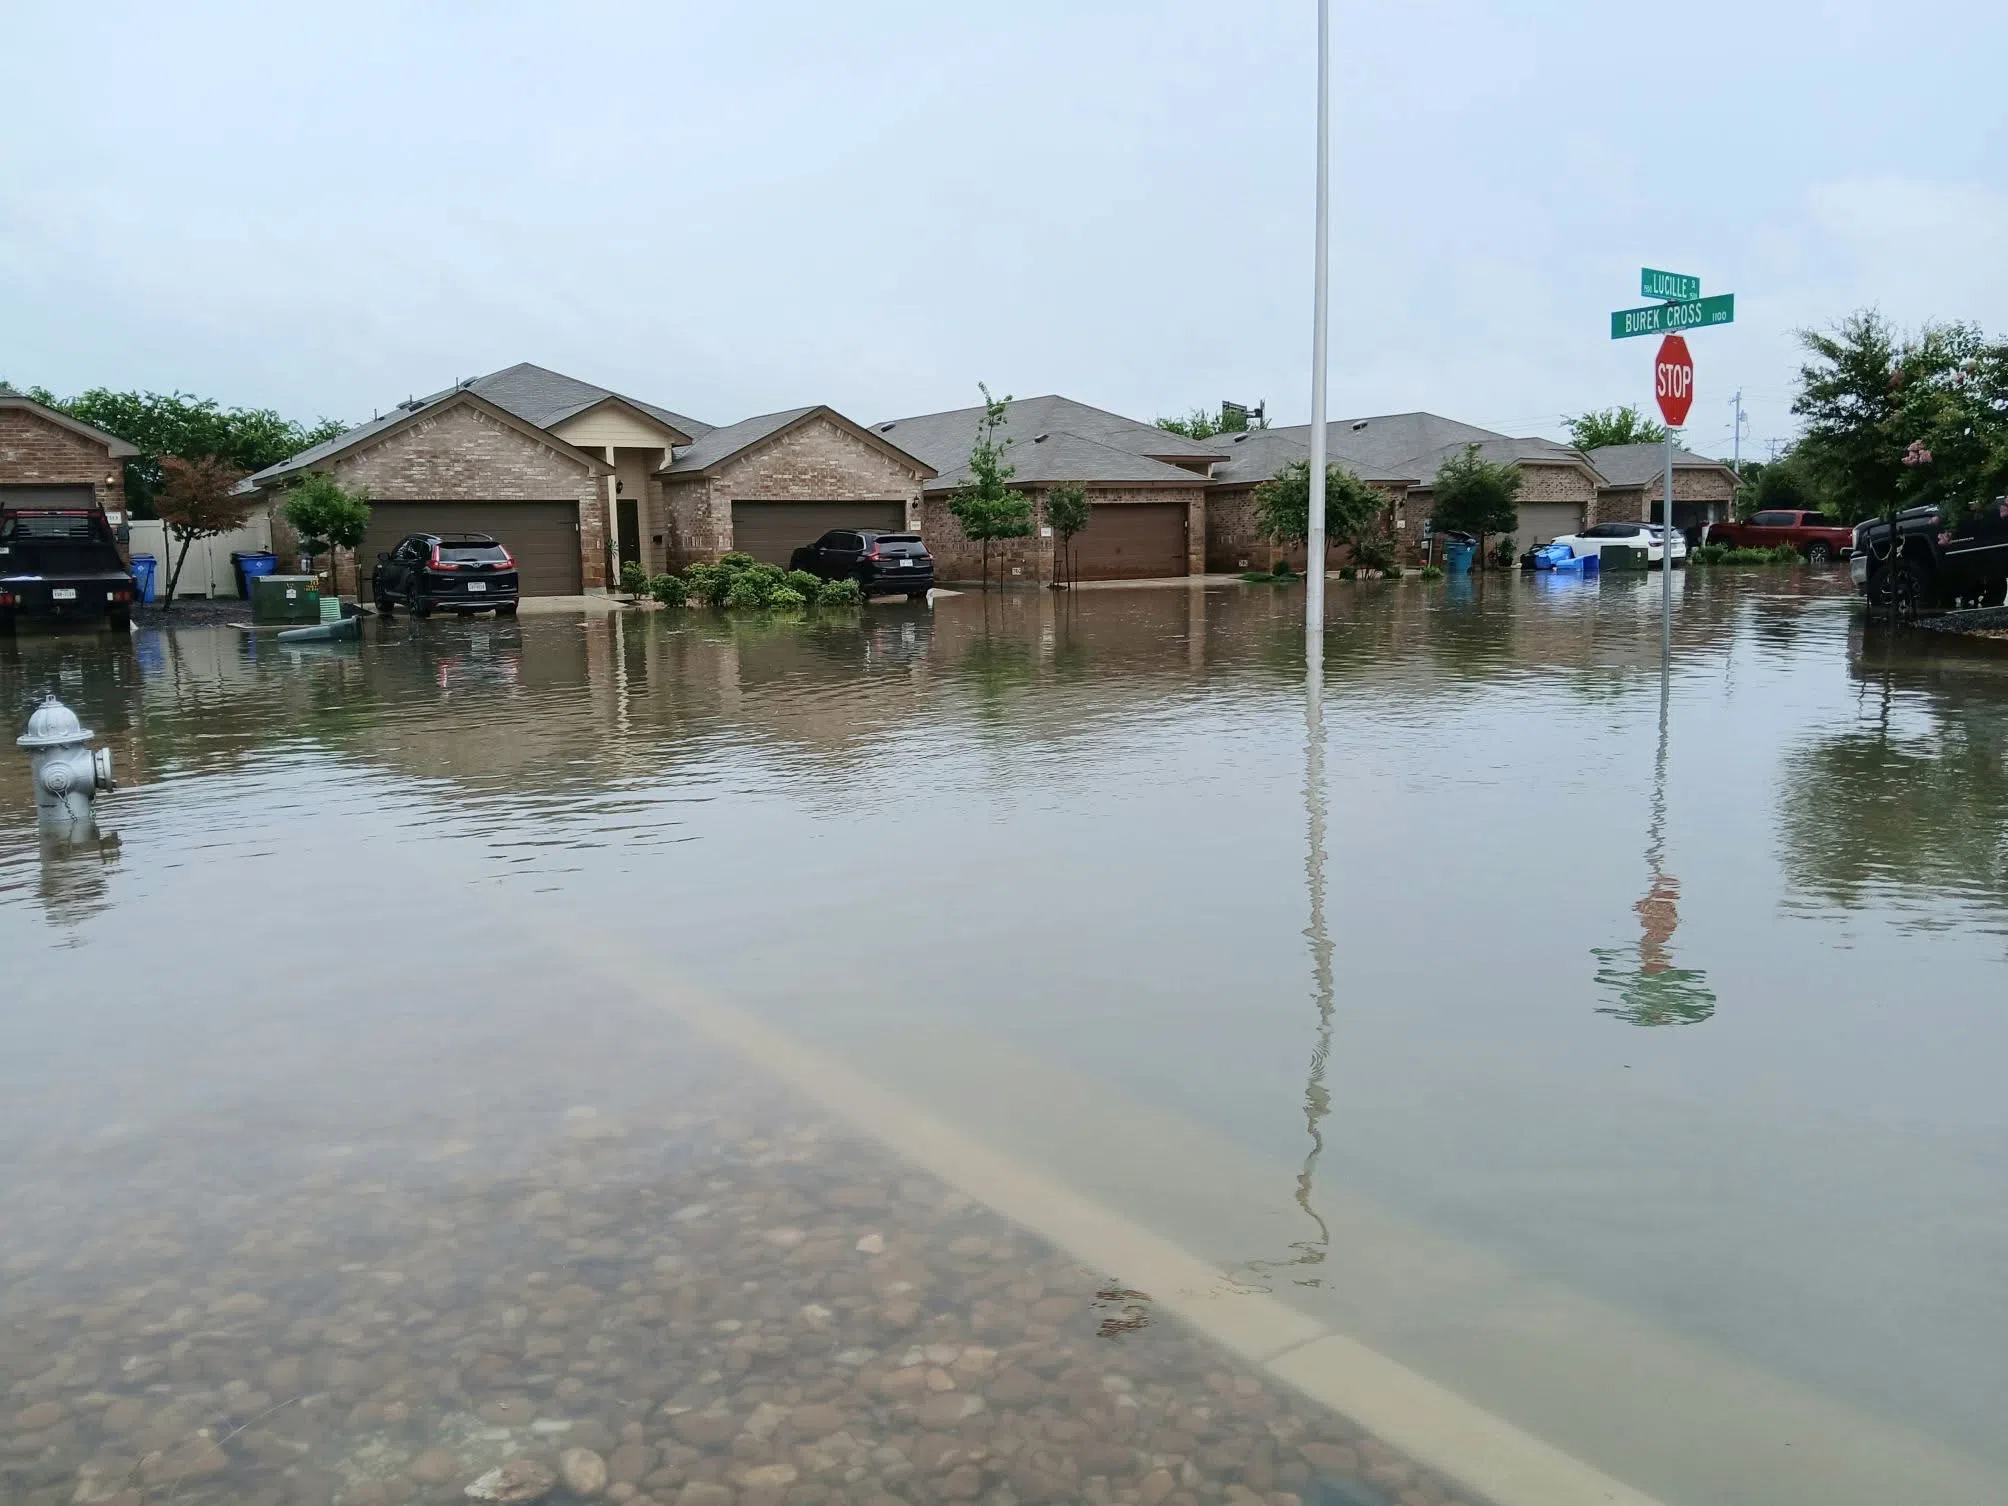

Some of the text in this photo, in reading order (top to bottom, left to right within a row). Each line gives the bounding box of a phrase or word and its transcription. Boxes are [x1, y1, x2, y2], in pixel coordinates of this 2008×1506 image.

[1653, 273, 1687, 298] LUCILLE
[1625, 309, 1660, 333] BUREK
[1667, 302, 1702, 327] CROSS
[1658, 362, 1691, 398] STOP
